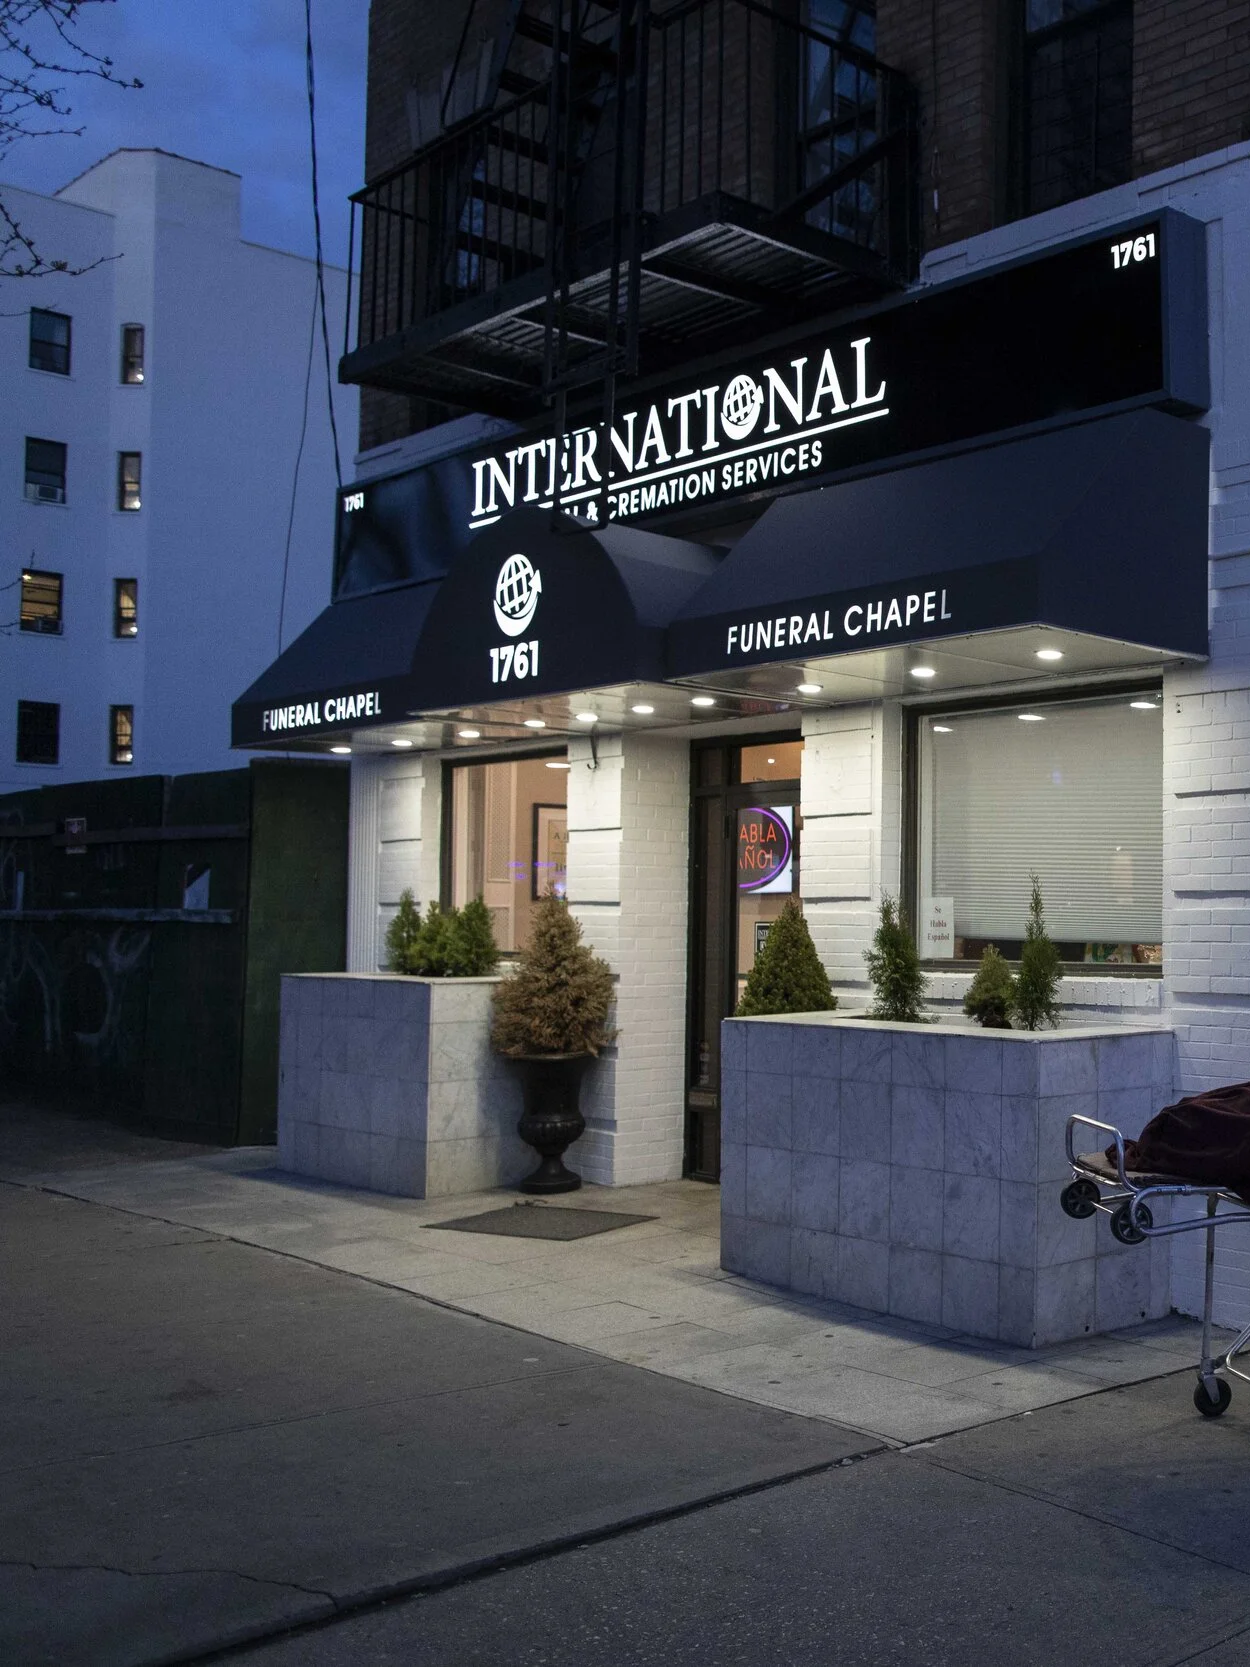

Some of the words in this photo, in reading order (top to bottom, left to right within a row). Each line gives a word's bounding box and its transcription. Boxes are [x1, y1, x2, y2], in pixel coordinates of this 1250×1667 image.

[1110, 232, 1156, 270] 1761
[470, 336, 888, 517] INTERNATIONAL
[585, 500, 599, 522] &
[721, 440, 823, 491] SERVICES
[343, 492, 364, 513] 1761
[726, 610, 834, 655] FUNERAL
[843, 589, 952, 637] CHAPEL
[489, 640, 540, 684] 1761
[262, 701, 321, 732] FUNERAL
[324, 692, 382, 722] CHAPEL
[740, 822, 778, 844] ABLA
